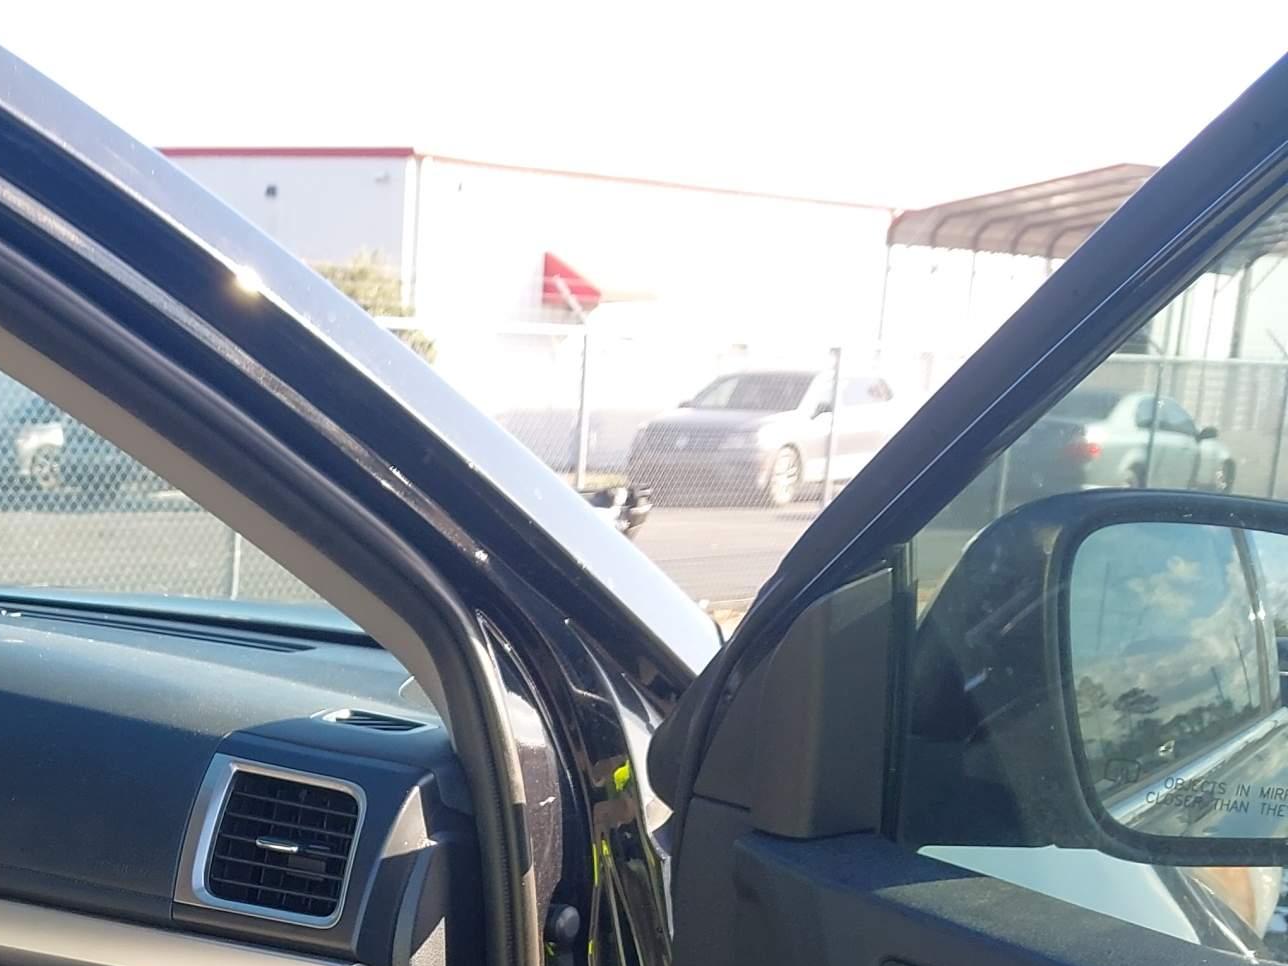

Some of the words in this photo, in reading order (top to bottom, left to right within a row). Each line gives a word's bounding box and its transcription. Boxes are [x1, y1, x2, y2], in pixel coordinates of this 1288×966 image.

[1164, 776, 1227, 796] OBJECTS
[1235, 783, 1251, 798] IN
[1145, 791, 1203, 809] CLOSER
[1213, 797, 1250, 814] THAN
[1260, 802, 1288, 818] THE
